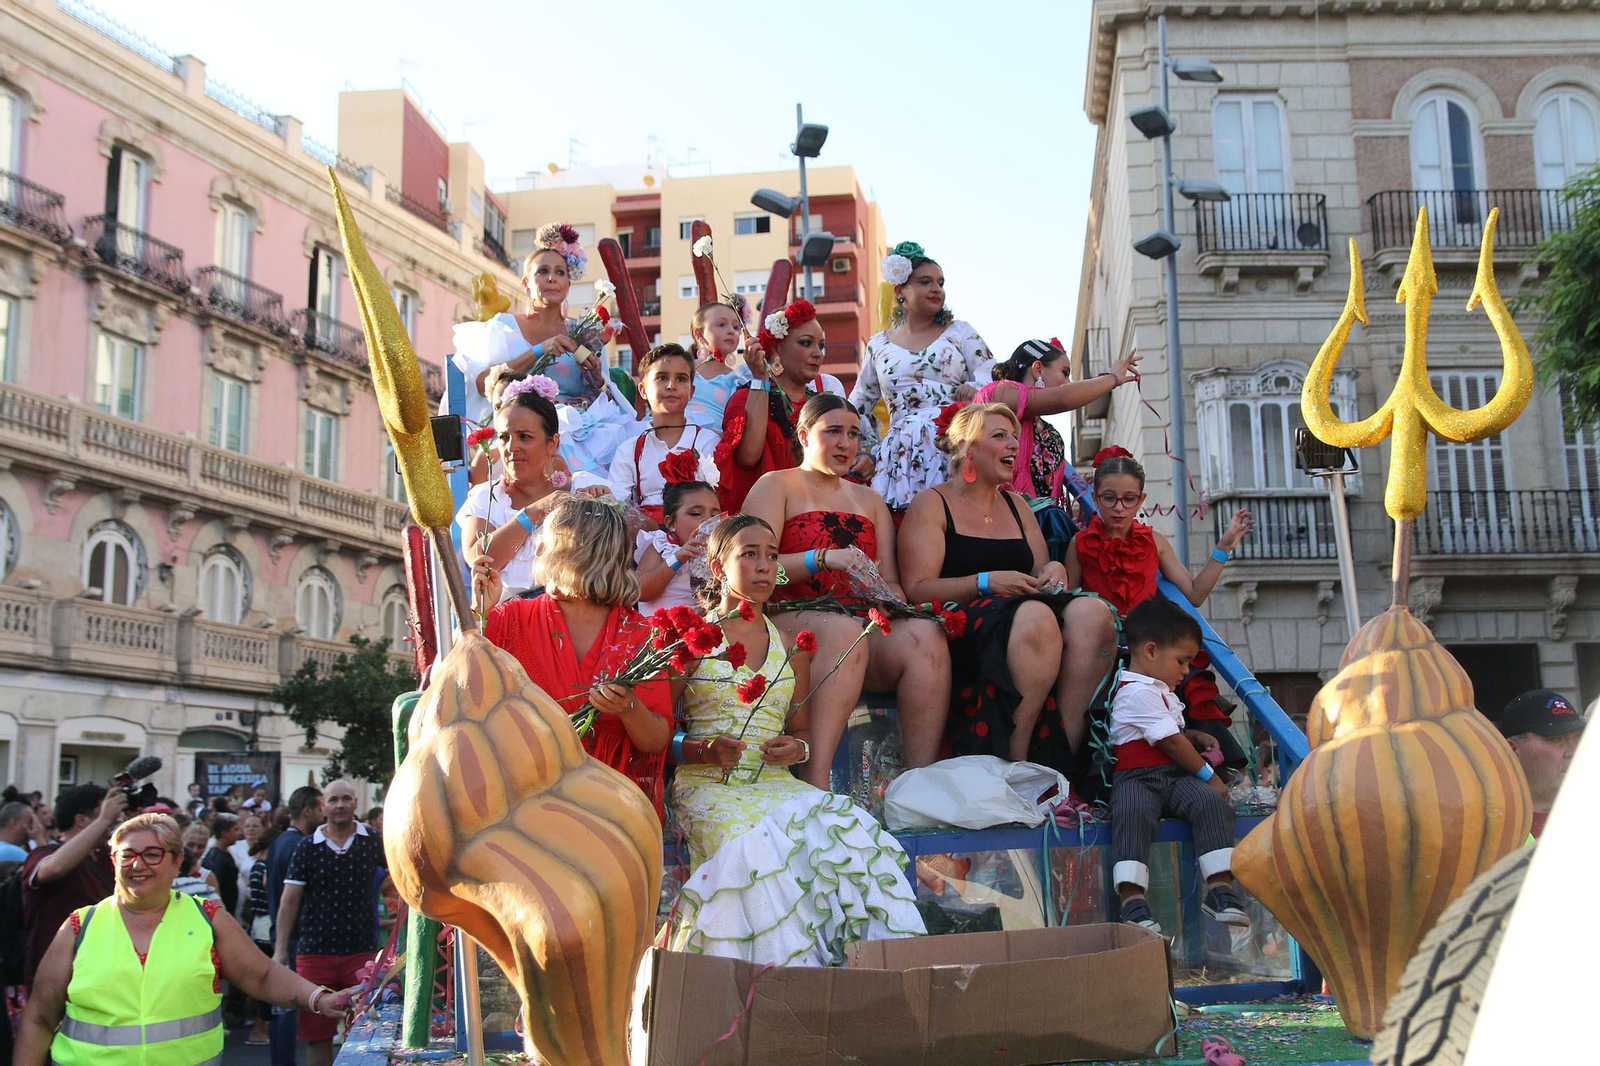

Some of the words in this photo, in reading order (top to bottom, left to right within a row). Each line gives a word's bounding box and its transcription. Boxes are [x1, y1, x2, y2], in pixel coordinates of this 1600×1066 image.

[207, 764, 220, 774] EL
[221, 764, 252, 774] AGUA
[207, 774, 220, 784] TE
[221, 774, 268, 784] NECESITA
